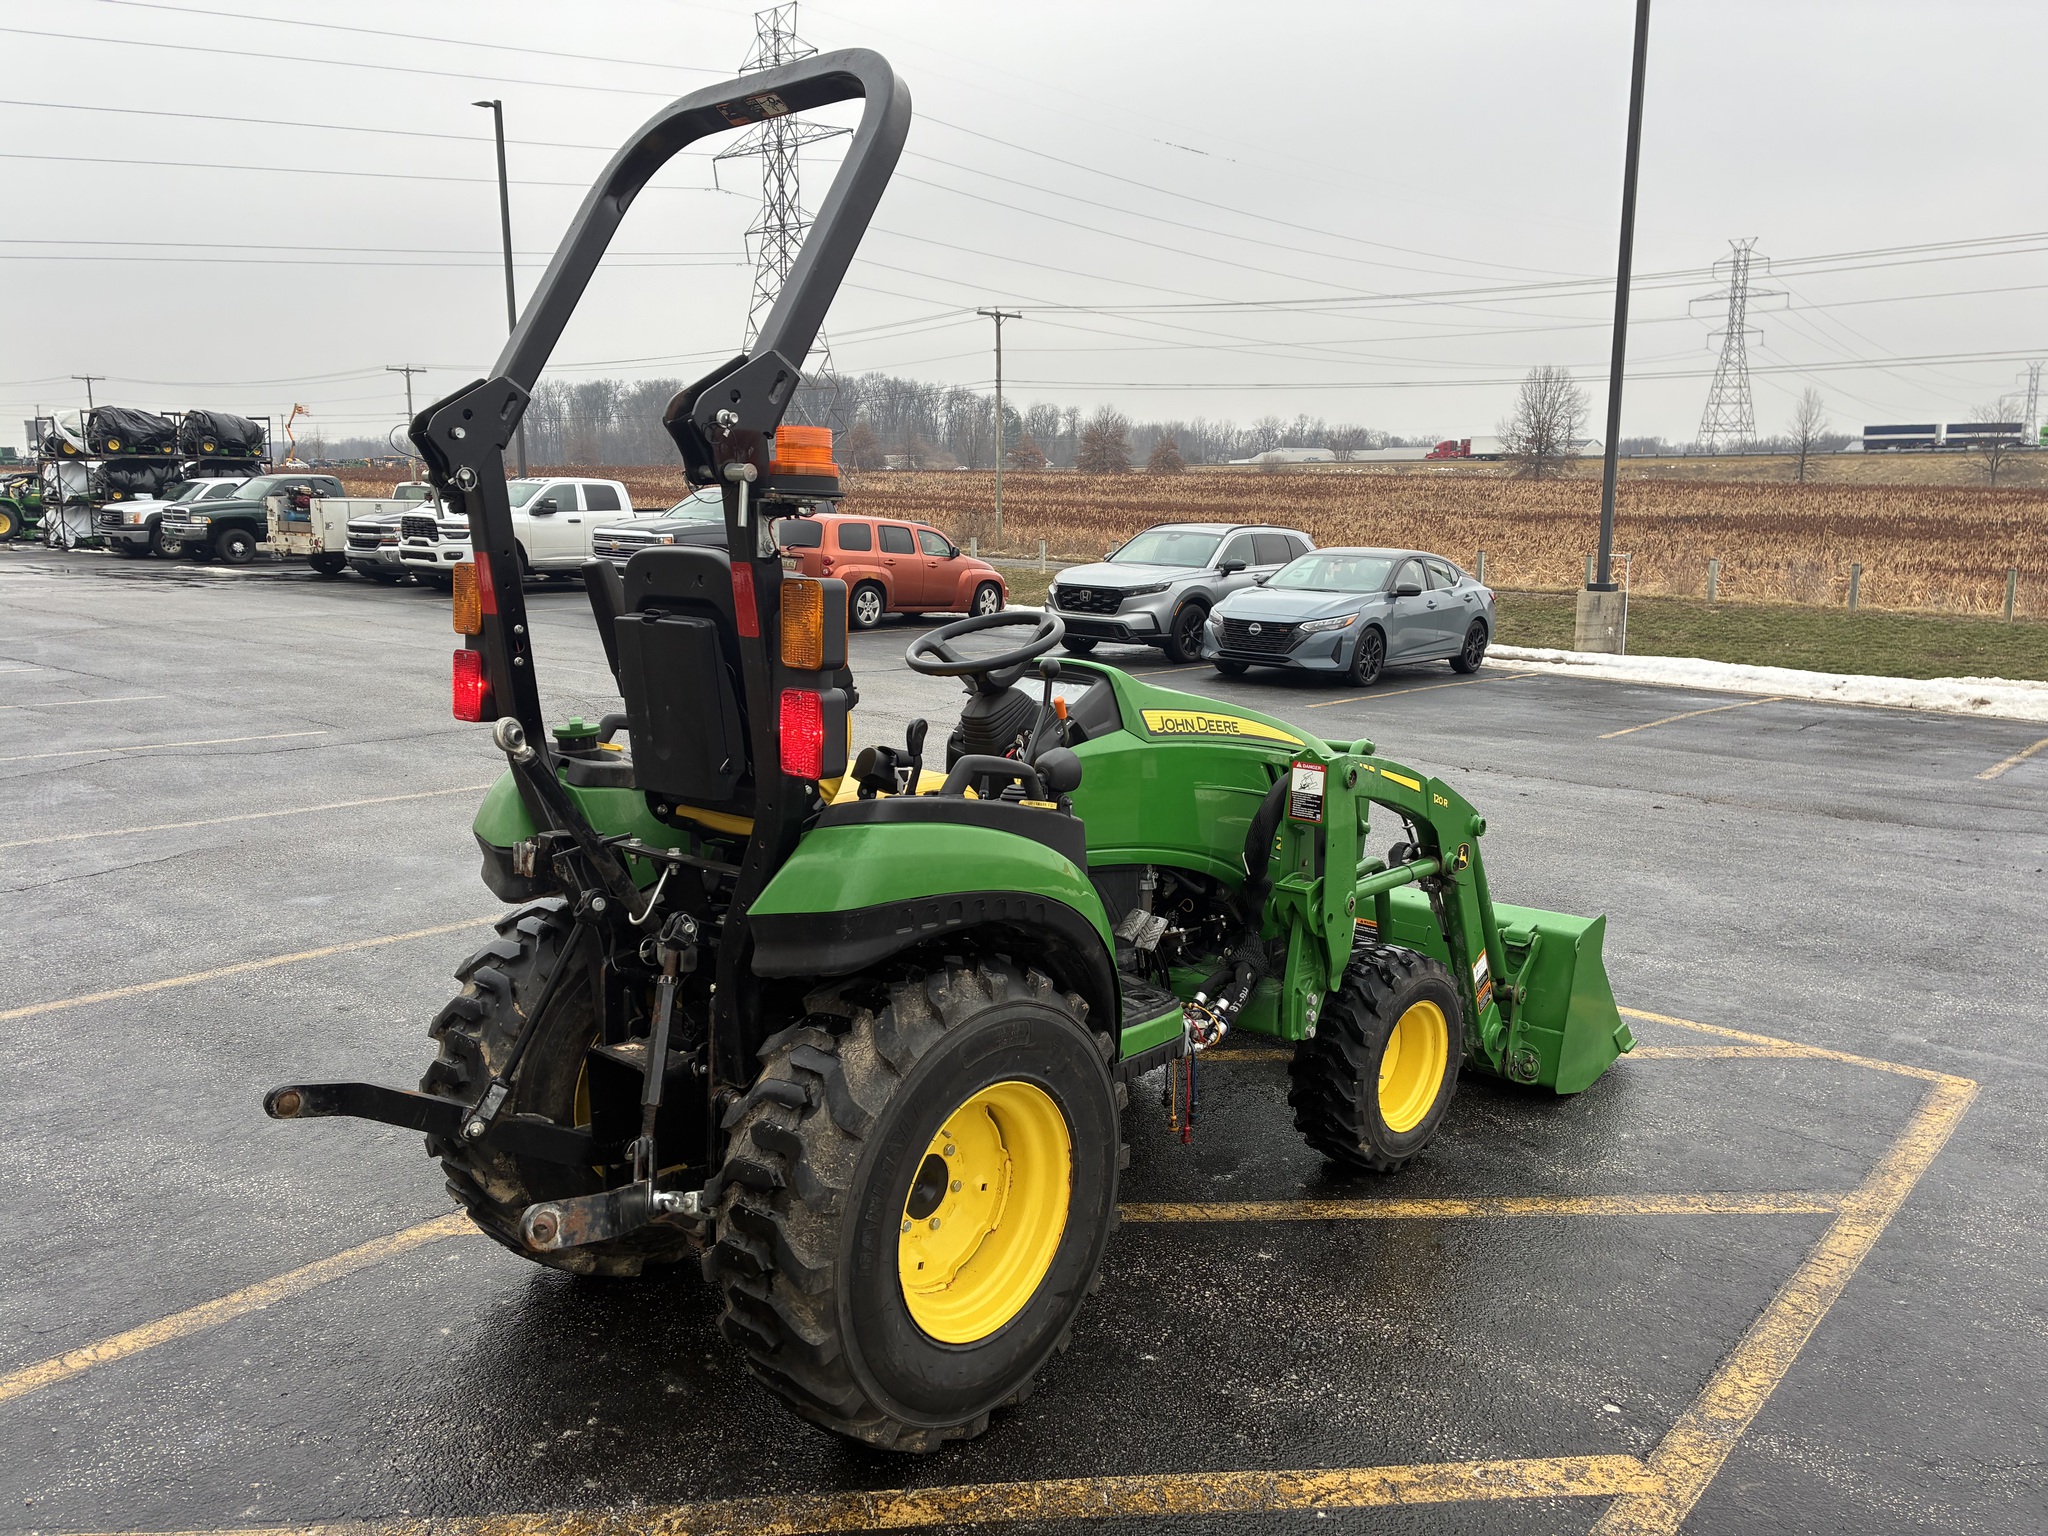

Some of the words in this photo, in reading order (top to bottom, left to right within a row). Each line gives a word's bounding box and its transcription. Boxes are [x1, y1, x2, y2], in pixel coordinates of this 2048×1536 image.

[1158, 716, 1195, 731] JOHN
[1196, 716, 1240, 733] DEERE
[1302, 763, 1322, 771] DANGER
